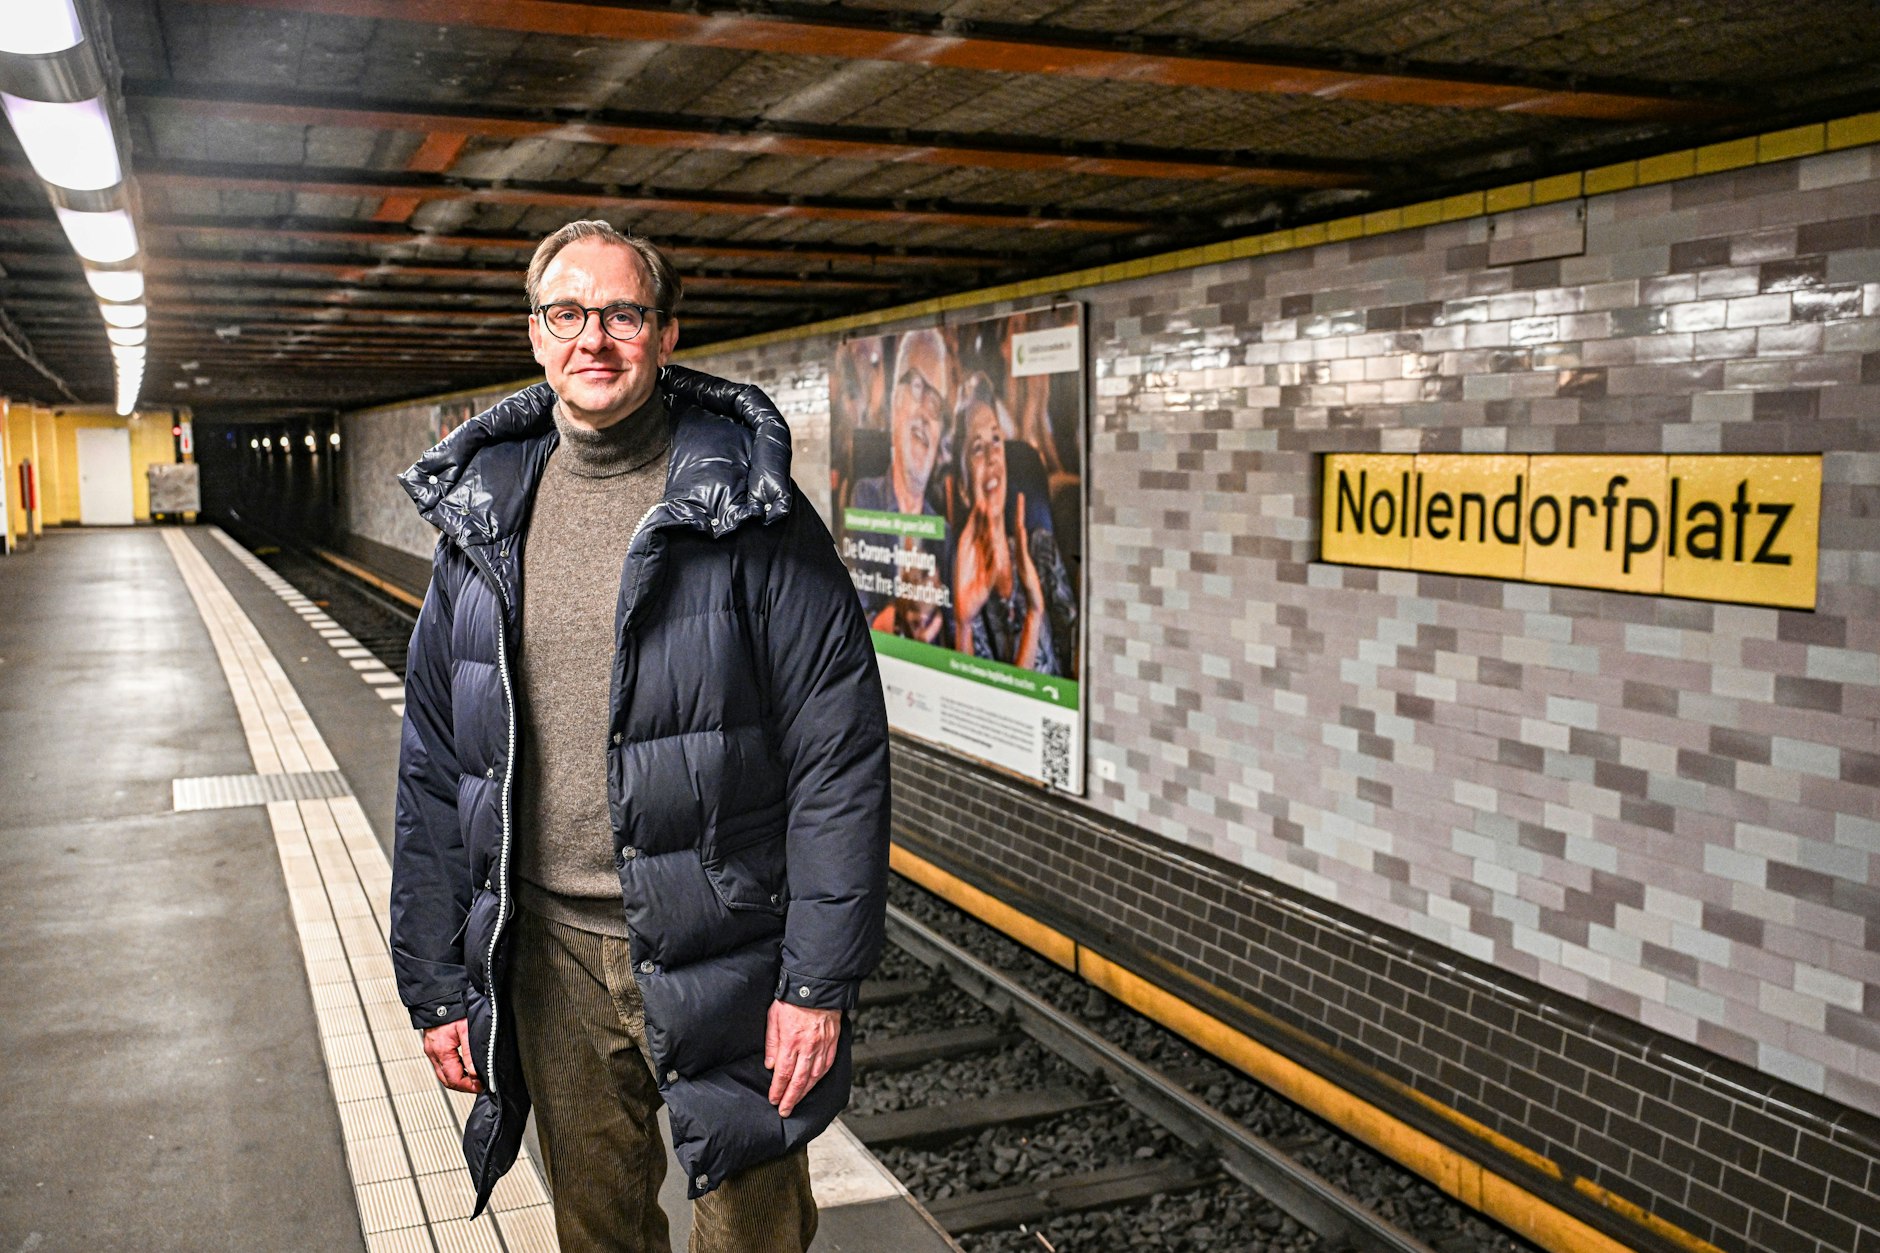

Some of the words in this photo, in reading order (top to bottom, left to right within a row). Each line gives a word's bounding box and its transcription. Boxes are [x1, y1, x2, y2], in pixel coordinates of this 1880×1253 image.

[1336, 469, 1795, 574] Nollendorfplatz
[843, 537, 857, 559] Die
[858, 539, 936, 577] Corona-Impfung
[875, 572, 893, 596] Ihre
